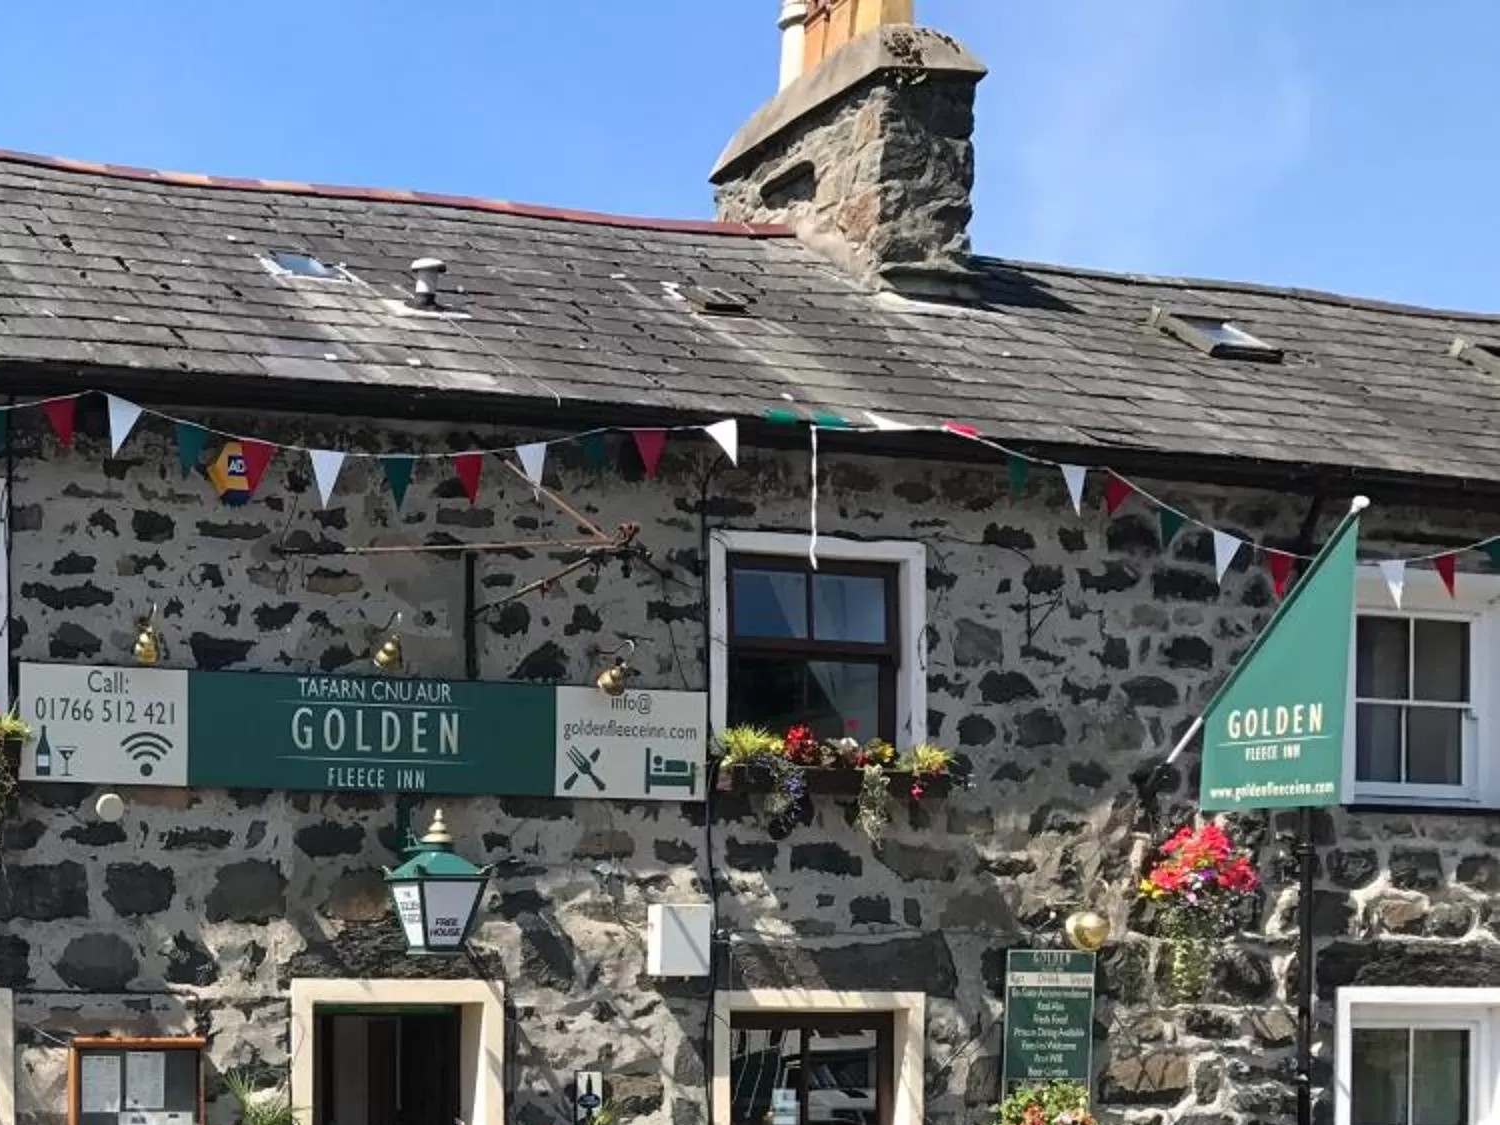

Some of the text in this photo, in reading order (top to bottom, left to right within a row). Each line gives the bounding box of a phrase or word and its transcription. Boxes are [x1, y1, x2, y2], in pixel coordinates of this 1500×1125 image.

[87, 669, 130, 694] Call:
[297, 677, 366, 699] TAFARN
[35, 697, 175, 725] 01766 512 421
[611, 693, 652, 714] info@
[291, 706, 460, 755] GOLDEN
[563, 719, 697, 740] goldenfleeceinn.com
[1227, 702, 1323, 739] GOLDEN
[1244, 743, 1301, 761] FLEECE INN
[327, 767, 426, 789] FLEECE INN
[1209, 781, 1335, 802] www.goldenfleeceinn.com
[435, 917, 459, 926] FREE
[429, 928, 462, 937] HOUSE
